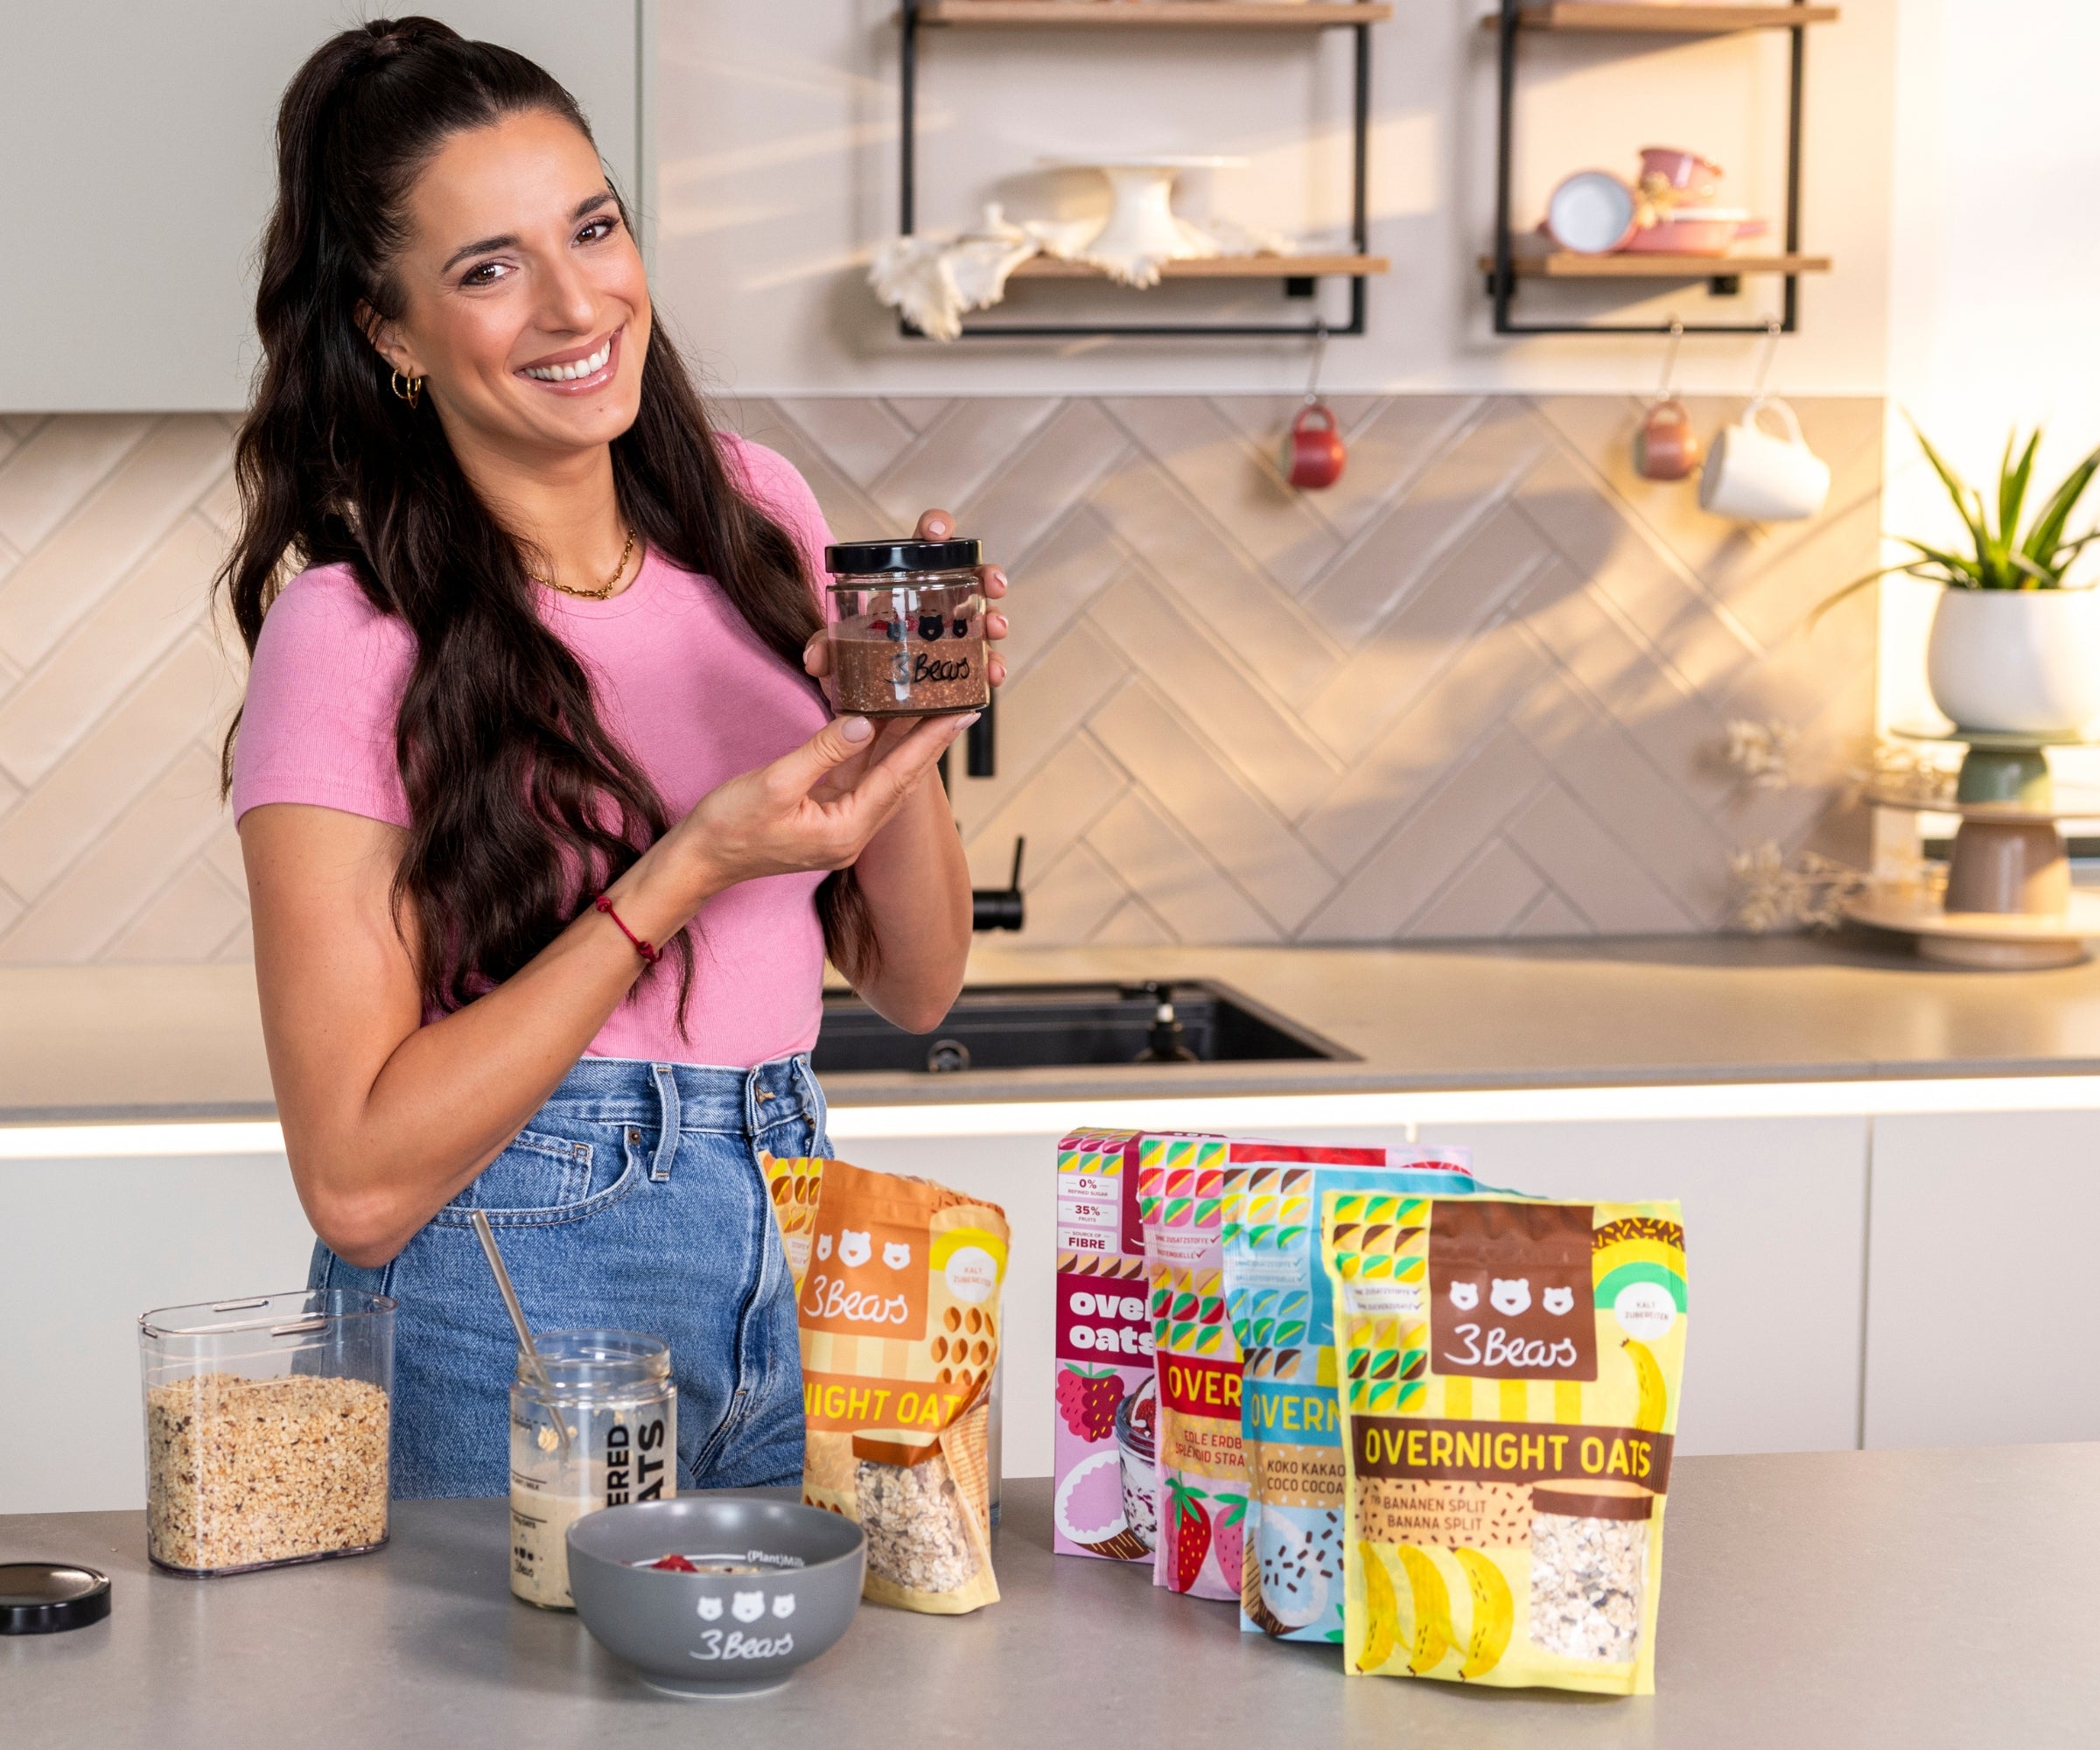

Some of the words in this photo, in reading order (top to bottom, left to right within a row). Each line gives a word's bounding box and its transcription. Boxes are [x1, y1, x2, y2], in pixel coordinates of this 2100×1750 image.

[1079, 1179, 1097, 1189] 0%
[1075, 1205, 1101, 1216] 35%
[1068, 1237, 1106, 1250] FIBRE
[803, 1275, 908, 1325] 3Bears
[1444, 1323, 1578, 1368] 3Bears
[1168, 1365, 1242, 1407] OVER
[1184, 1430, 1208, 1446] EDLE
[1211, 1433, 1242, 1450] ERDB
[1175, 1441, 1212, 1463] SPLENDID
[1214, 1451, 1245, 1467] STRA
[1364, 1427, 1570, 1472] OVERNIGHT
[1579, 1436, 1652, 1479] OATS
[1267, 1460, 1298, 1474] KOKO
[1301, 1462, 1347, 1478] KAKAO
[1267, 1477, 1298, 1492] COCO
[1301, 1480, 1345, 1494] COCOA
[1383, 1496, 1445, 1512] BANANEN
[1448, 1499, 1487, 1514] SPLIT
[1387, 1515, 1440, 1529] BANANA
[1444, 1517, 1482, 1530] SPLIT
[689, 1628, 794, 1661] 3Bears
